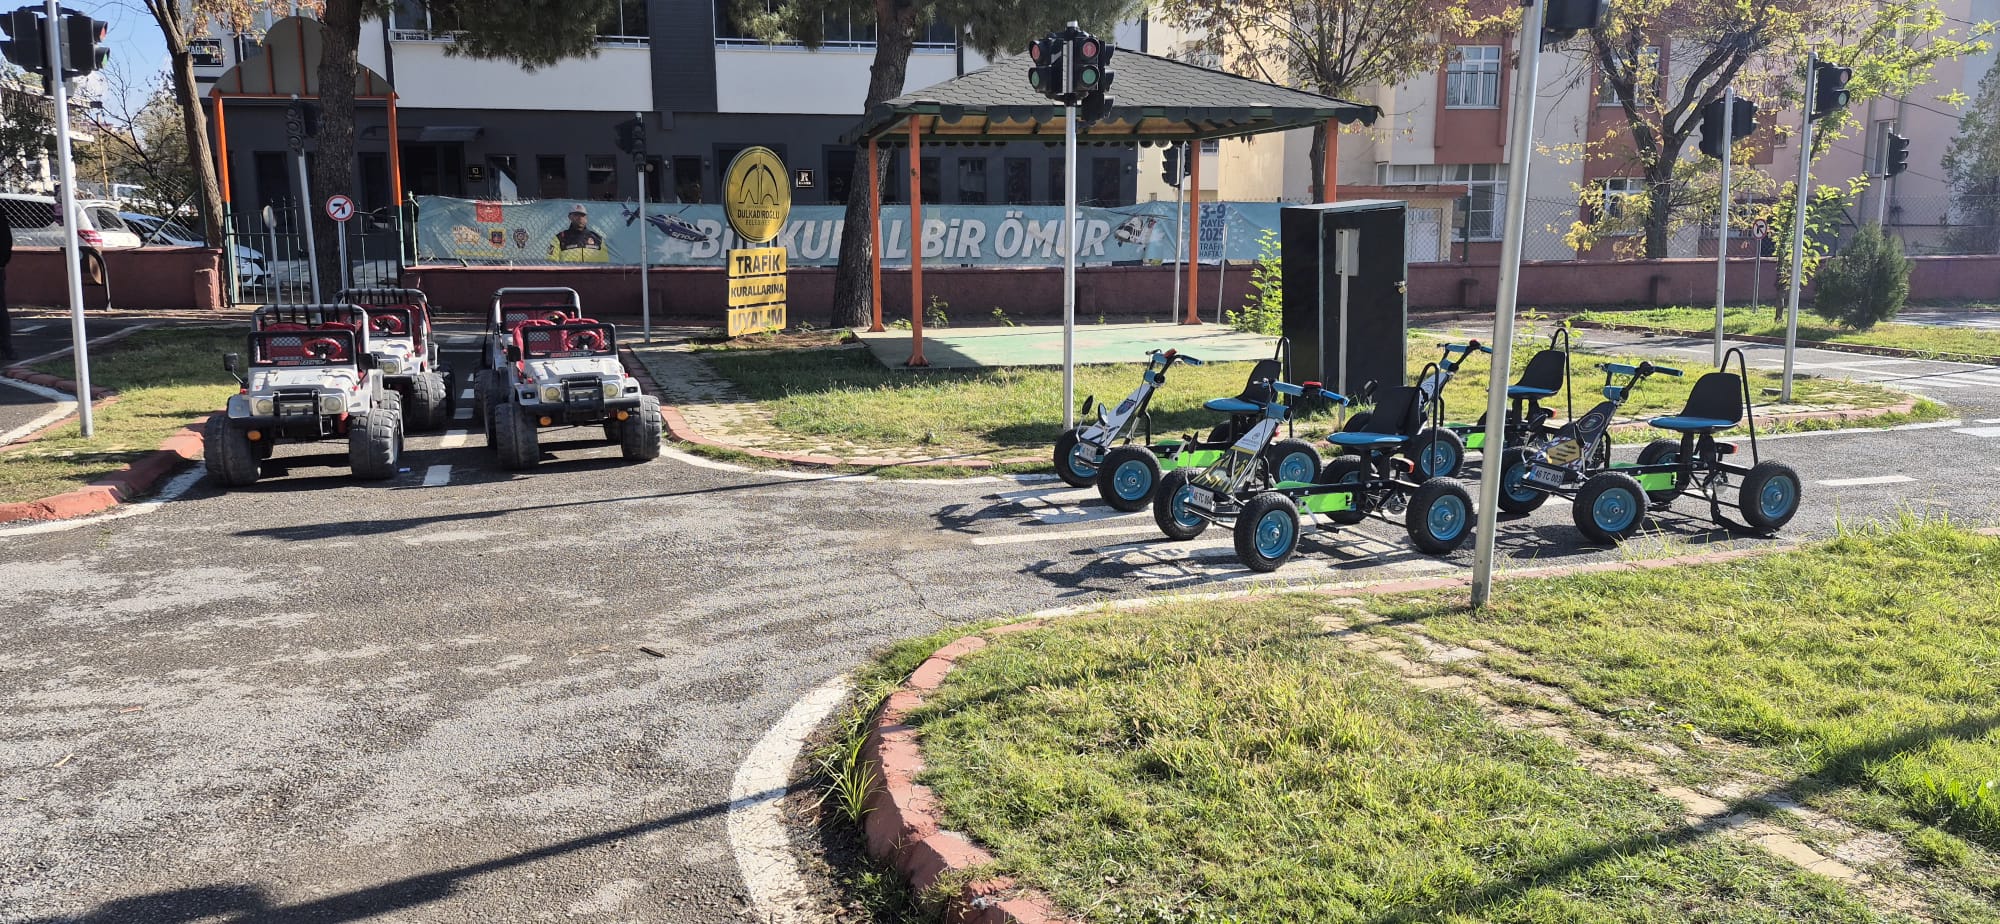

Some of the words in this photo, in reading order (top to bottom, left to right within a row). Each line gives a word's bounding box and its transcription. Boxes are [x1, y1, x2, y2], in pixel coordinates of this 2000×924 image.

[1200, 203, 1226, 219] 3-9
[1200, 219, 1225, 228] MAYIS
[1199, 228, 1224, 242] 2025
[735, 251, 781, 274] TRAFİK
[731, 283, 785, 298] KURALLARINA
[732, 308, 783, 331] UYALIM
